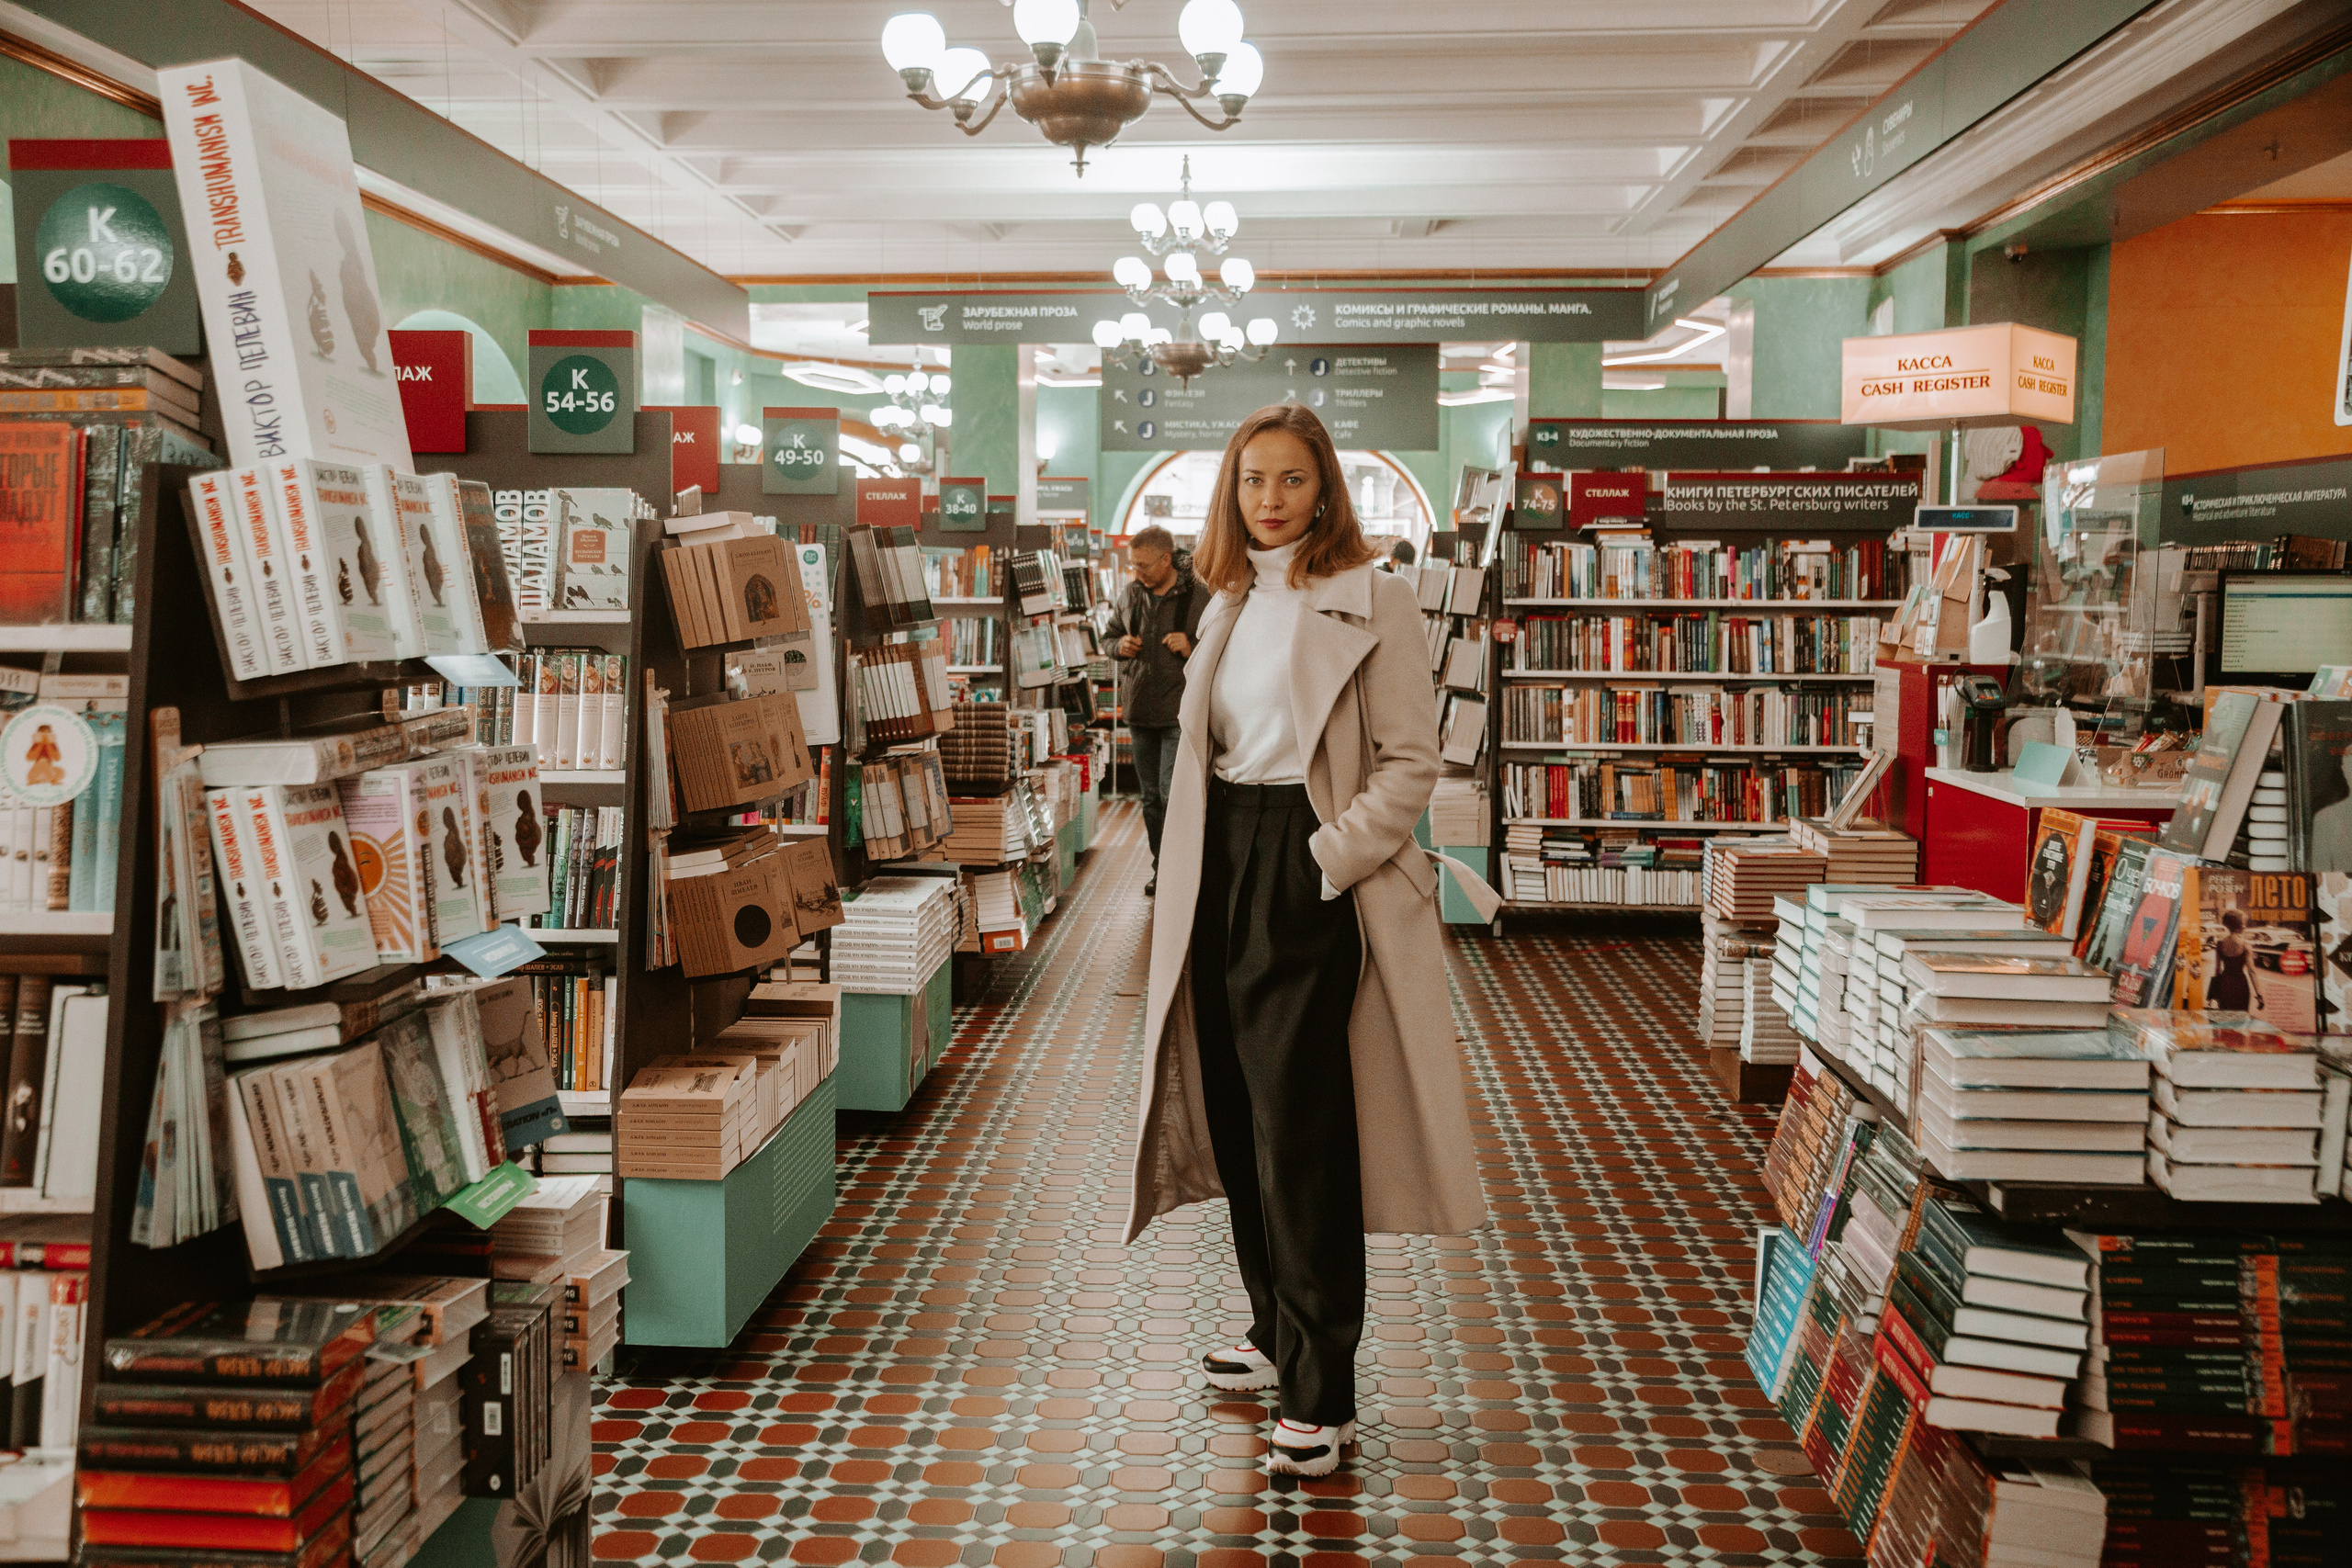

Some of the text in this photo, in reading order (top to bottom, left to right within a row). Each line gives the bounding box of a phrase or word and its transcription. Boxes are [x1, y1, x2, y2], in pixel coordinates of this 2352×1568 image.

[193, 113, 246, 252] TRANSHUMANISM
[44, 250, 164, 283] 60-62
[963, 306, 1078, 318] ЗАРУБЕЖНАЯ ПРОЗА
[1335, 304, 1394, 315] КОМИКСЫ
[1396, 304, 1406, 315] И
[1407, 304, 1489, 315] ГРАФИЧЕСКИЕ
[964, 321, 1023, 332] World prose
[1335, 316, 1465, 330] Comics and graphic novels
[228, 289, 266, 372] ПЕЛЕВИН
[1897, 355, 1952, 371] КАССА
[2033, 355, 2054, 371] КАССА
[1861, 376, 1990, 396] CASH REGISTER
[2018, 376, 2067, 397] CASH REGISTER
[1336, 389, 1383, 399] ТРИЛЛЕРЫ
[546, 392, 615, 412] 54-56
[1335, 399, 1367, 408] Thrillers
[244, 377, 288, 458] ВИКТОР
[1334, 421, 1358, 429] КАФЕ
[673, 433, 695, 444] АЖ
[1199, 430, 1224, 438] horror
[1569, 429, 1778, 440] ХУДОЖЕСТВЕННО-ДОКУМЕНТАЛЬНАЯ ПРОЗА
[1569, 439, 1649, 449] Documentary fiction
[775, 449, 824, 466] 49-50
[865, 491, 907, 502] СТЕЛЛАЖ
[1586, 489, 1629, 497] СТЕЛЛАЖ
[1668, 482, 1918, 498] КНИГИ ПЕТЕРБУРГСКИХ ПИСАТЕЛЕЙ
[2238, 491, 2302, 505] ПРИКЛЮЧЕНЧЕСКАЯ
[2302, 488, 2346, 502] ЛИТЕРАТУРА
[945, 504, 977, 514] 38-40
[1523, 500, 1555, 510] 74-75
[1668, 499, 1889, 513] Books by the St. Petersburg writers
[523, 491, 548, 610] ШАЛАМОВ
[502, 1111, 539, 1132] ERATION
